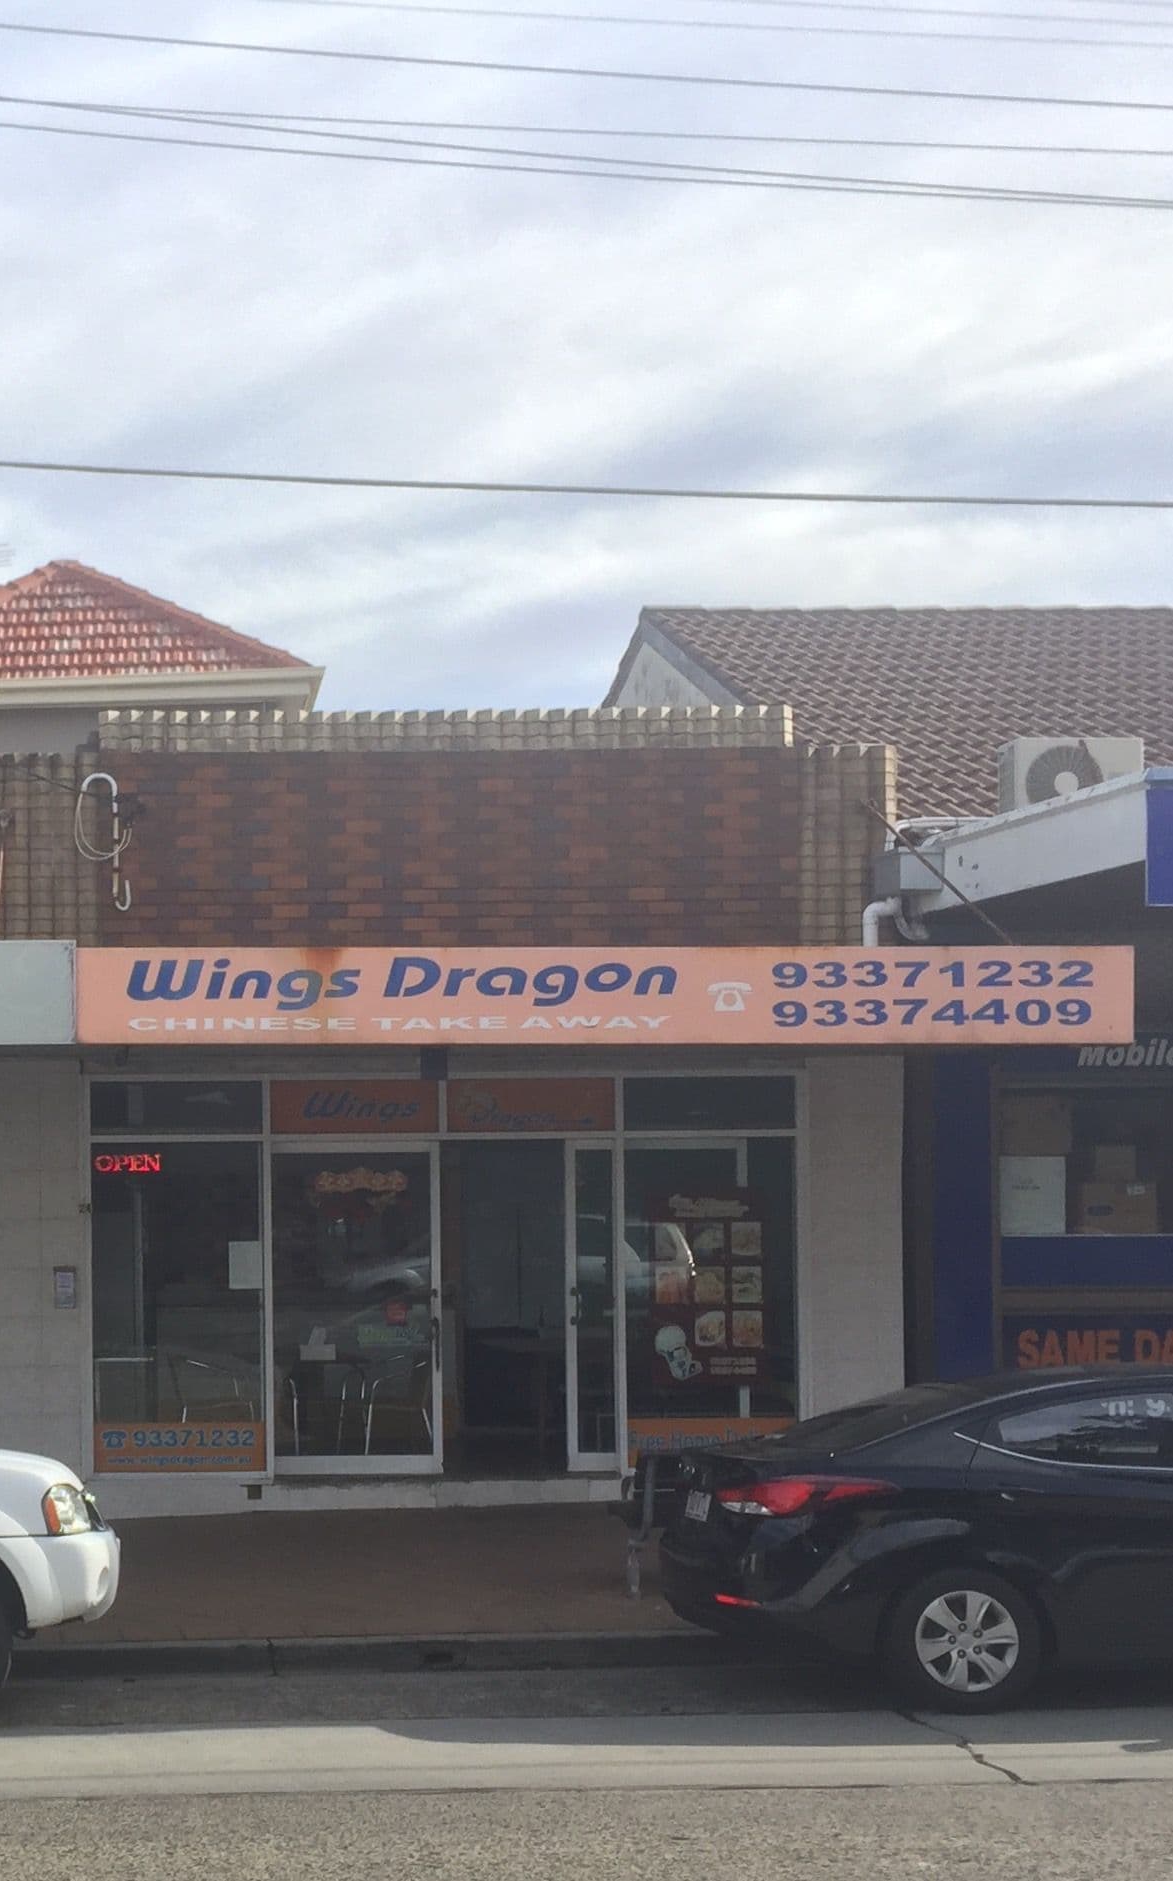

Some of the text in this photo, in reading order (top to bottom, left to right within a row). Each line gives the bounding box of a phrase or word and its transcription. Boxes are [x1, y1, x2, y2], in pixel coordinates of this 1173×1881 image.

[126, 957, 677, 1011] Wings Dragon
[772, 960, 1094, 989] 93371232
[128, 1016, 670, 1031] CHINESE TAKE AWAY
[772, 999, 1092, 1027] 93374409
[302, 1090, 421, 1121] Wings
[94, 1154, 161, 1173] OPEN
[1018, 1328, 1120, 1370] SAME
[133, 1429, 254, 1448] 93371232
